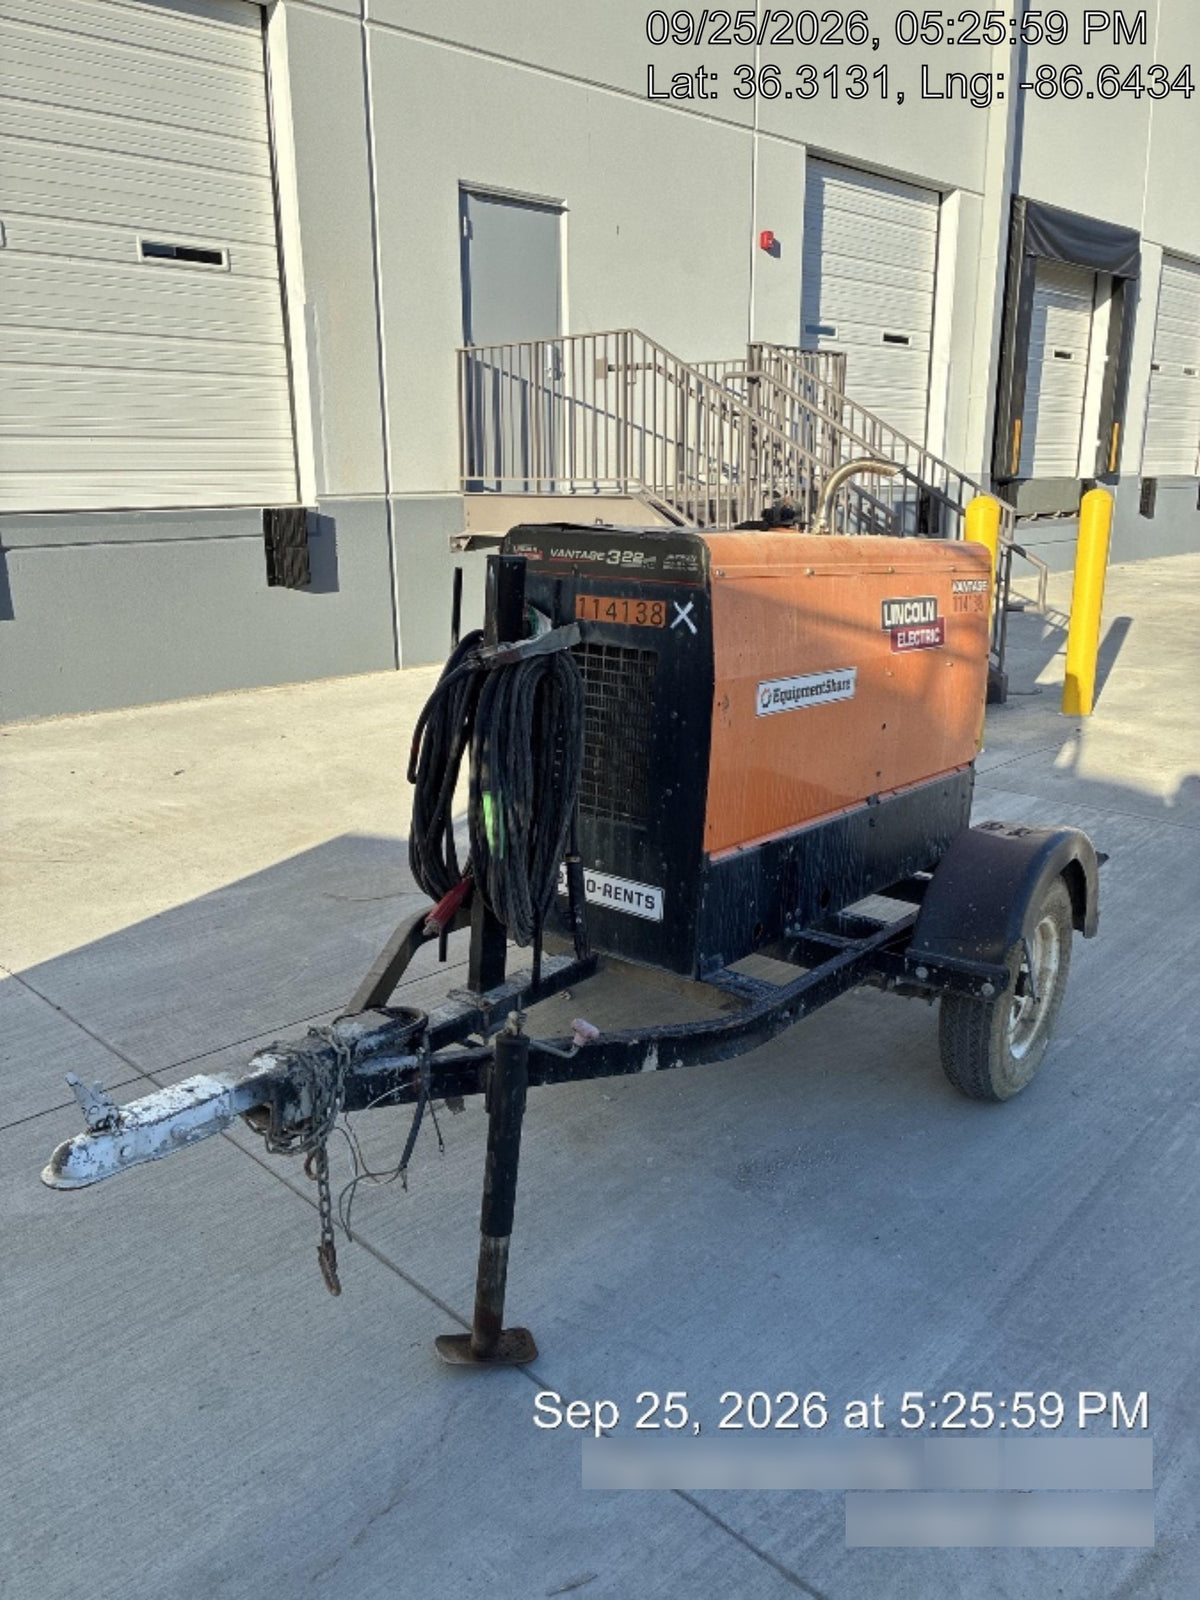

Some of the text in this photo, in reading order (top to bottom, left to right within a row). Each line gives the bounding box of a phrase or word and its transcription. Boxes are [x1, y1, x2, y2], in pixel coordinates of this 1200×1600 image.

[550, 548, 606, 561] VANTAGE
[606, 549, 644, 565] 322
[952, 579, 988, 593] VANTAGE
[578, 597, 663, 625] 114138
[883, 601, 935, 627] LINCOLN
[897, 627, 940, 648] ELECTRIC
[773, 679, 851, 705] EquipmentShare
